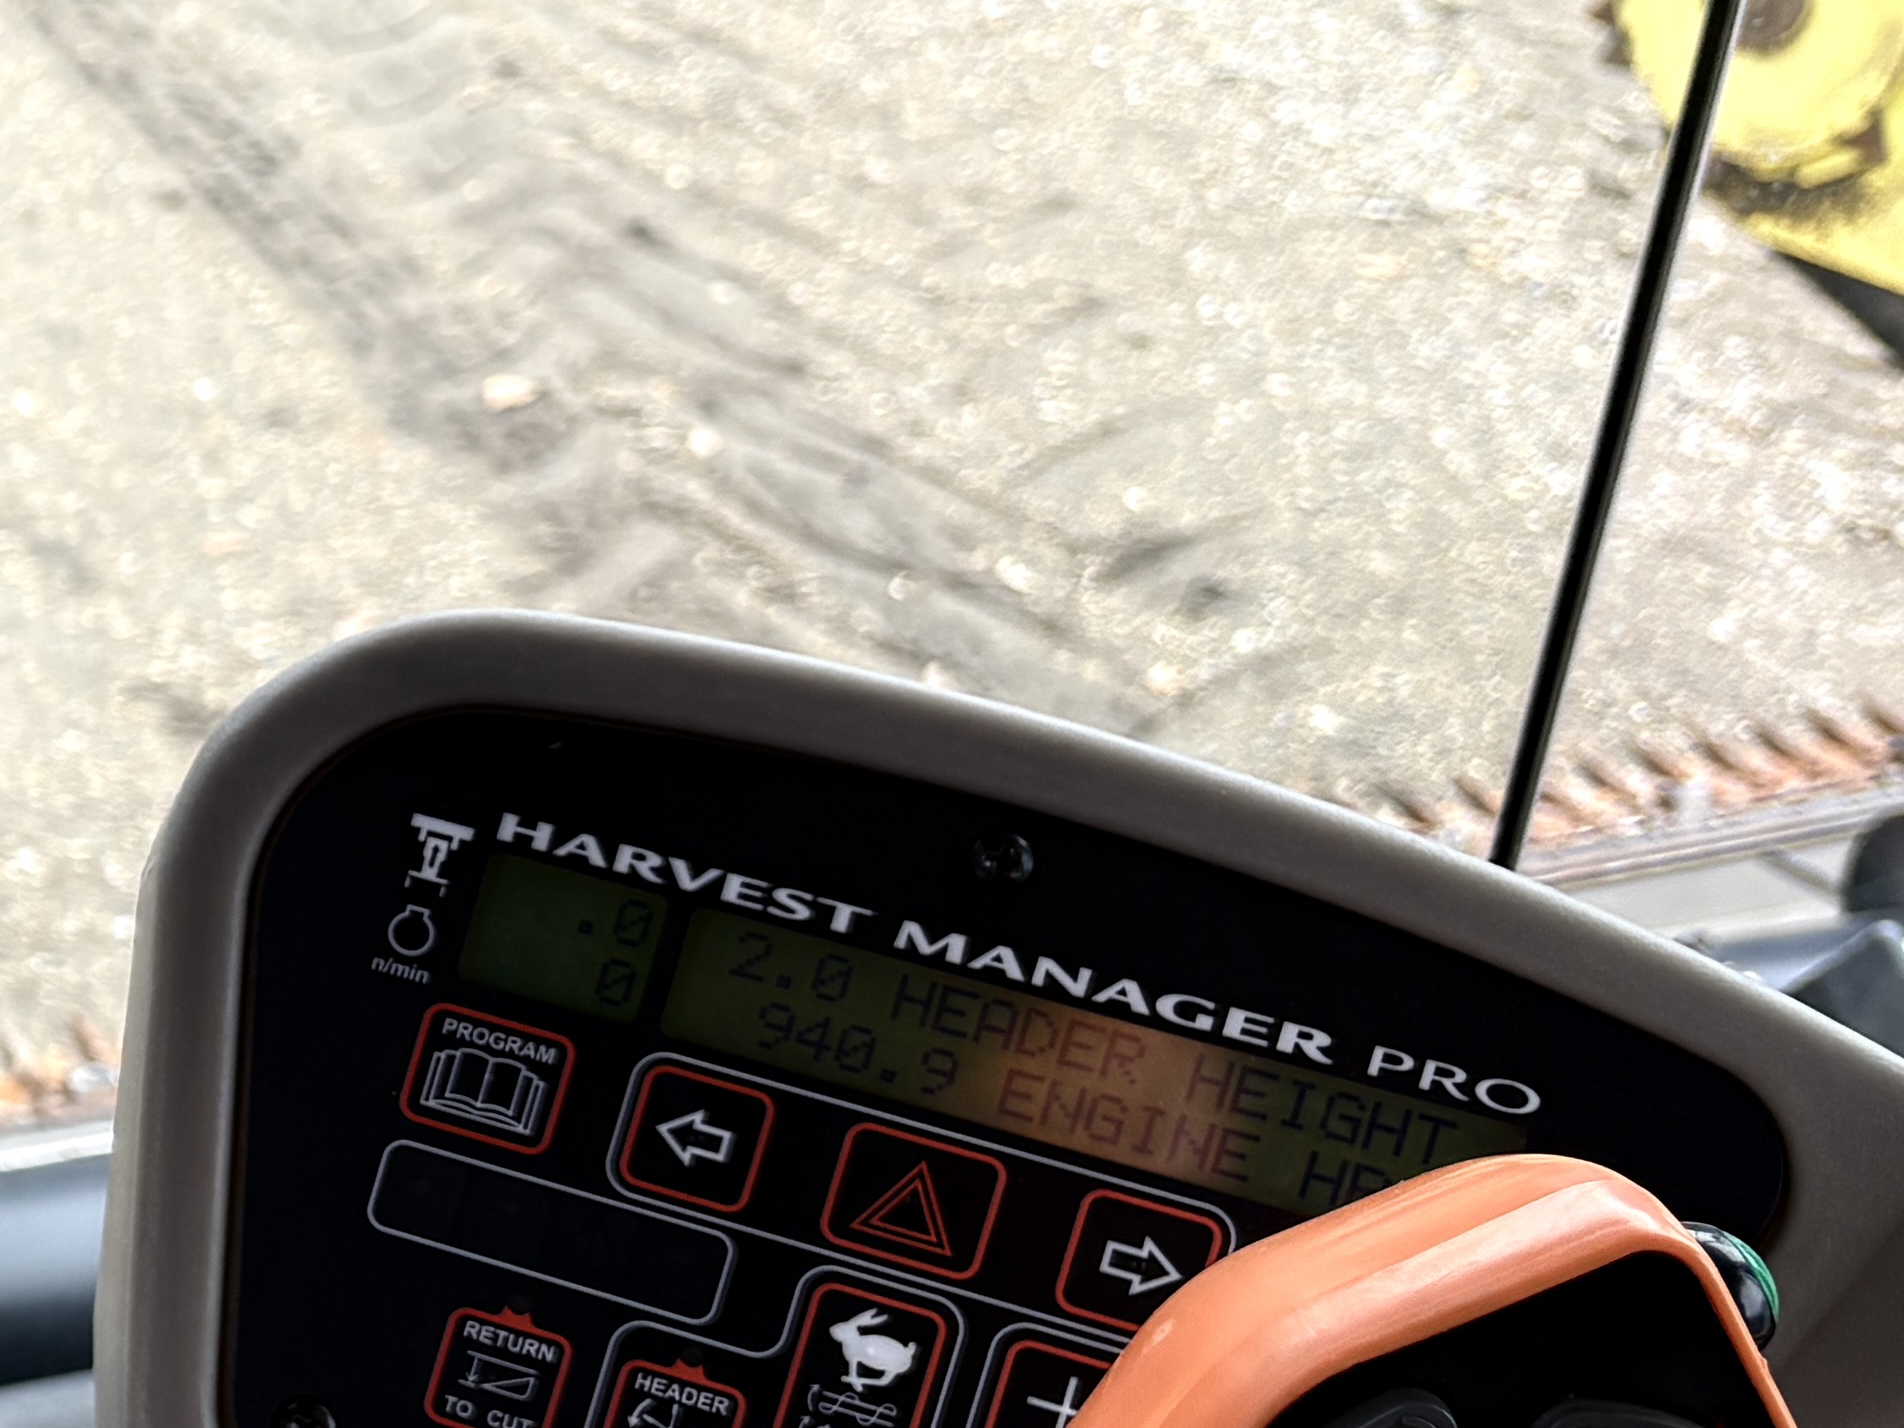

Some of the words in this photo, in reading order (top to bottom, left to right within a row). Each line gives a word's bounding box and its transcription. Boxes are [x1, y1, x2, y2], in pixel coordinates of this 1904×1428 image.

[370, 956, 432, 985] n/min
[495, 811, 879, 934] HARVEST
[892, 919, 1334, 1066] MANAGER
[1366, 1044, 1542, 1116] PRO
[441, 1016, 560, 1065] PROGRAM
[728, 931, 855, 1003] 2.0
[890, 973, 1146, 1085] HEADER
[1186, 1052, 1459, 1166] HEIGHT
[757, 1002, 960, 1096] 940.9
[996, 1067, 1262, 1183] ENGINE
[462, 1320, 557, 1363] RETURN
[443, 1394, 477, 1420] TO
[634, 1372, 731, 1416] HEADER
